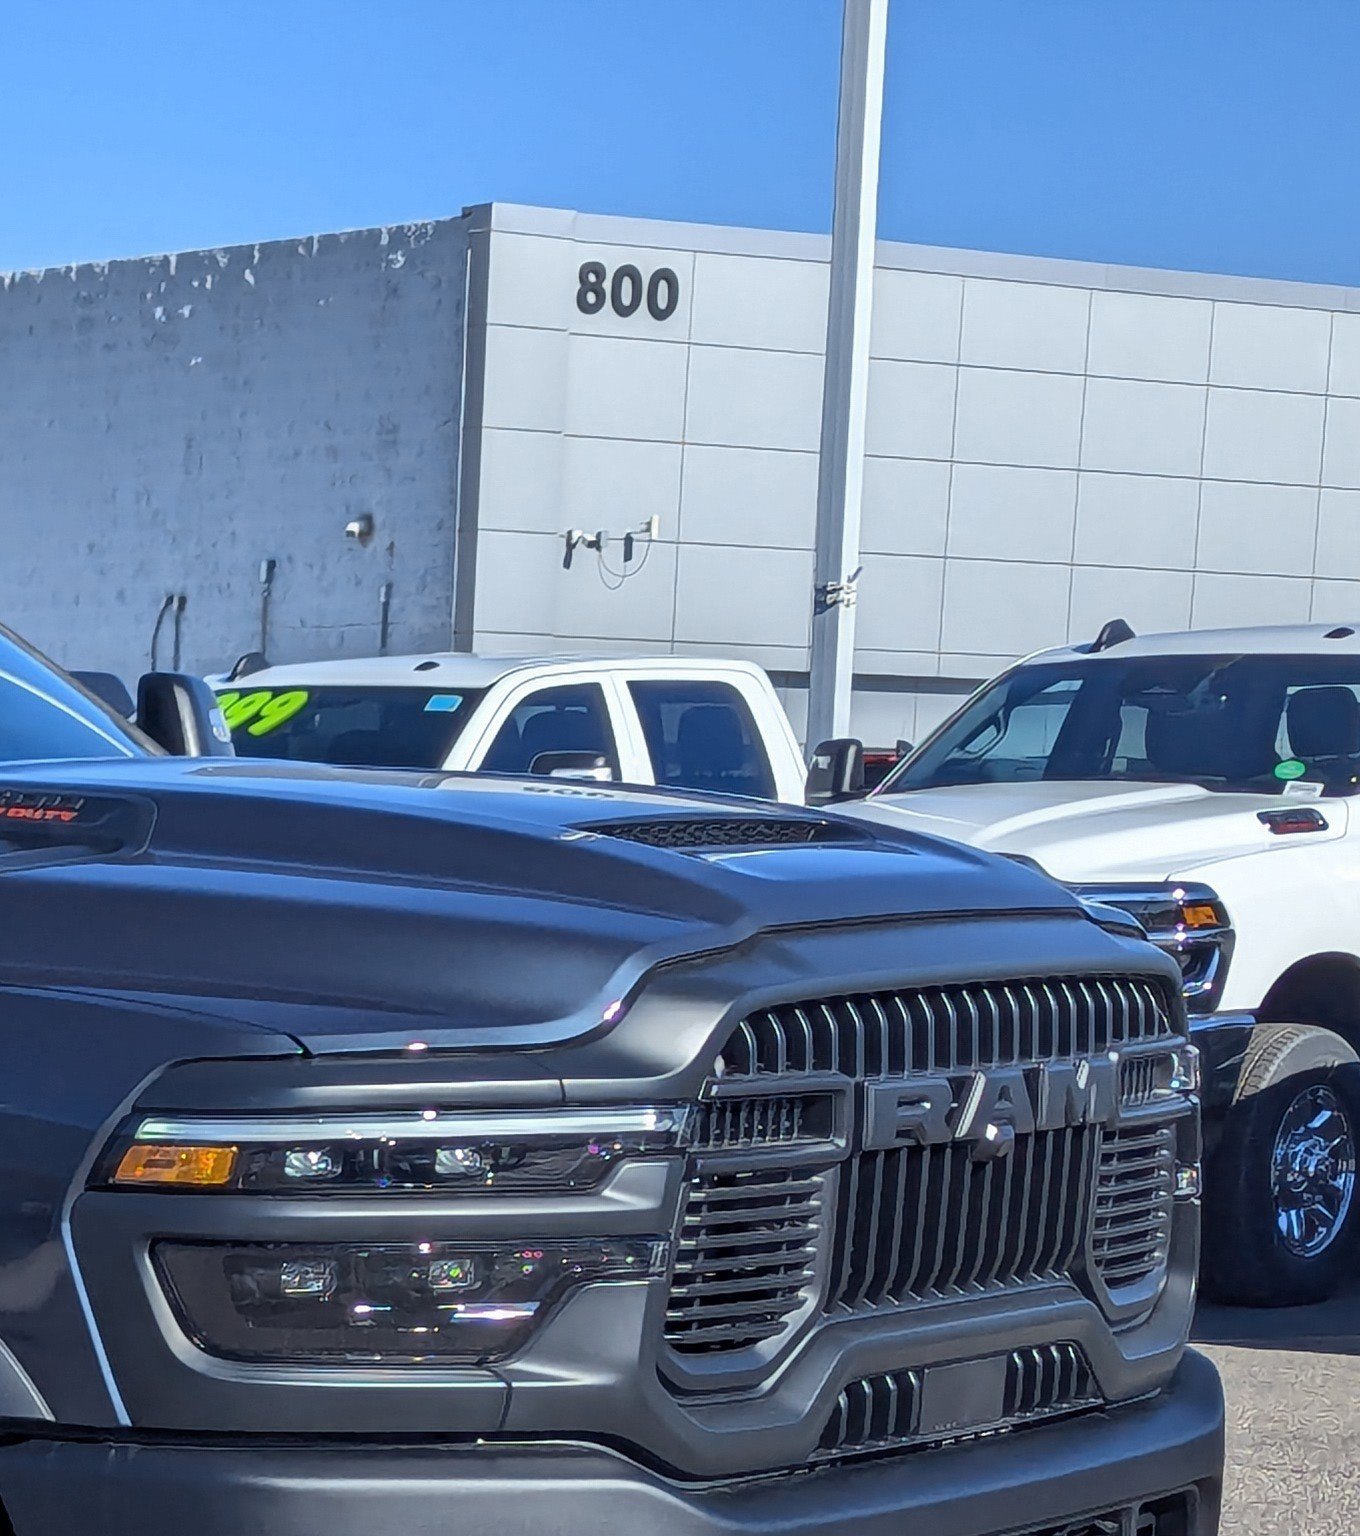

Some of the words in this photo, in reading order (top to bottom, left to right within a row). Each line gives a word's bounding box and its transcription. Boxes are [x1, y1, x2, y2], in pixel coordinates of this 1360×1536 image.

[576, 261, 679, 321] 800
[216, 691, 308, 736] 99
[862, 1058, 1116, 1152] RAM
